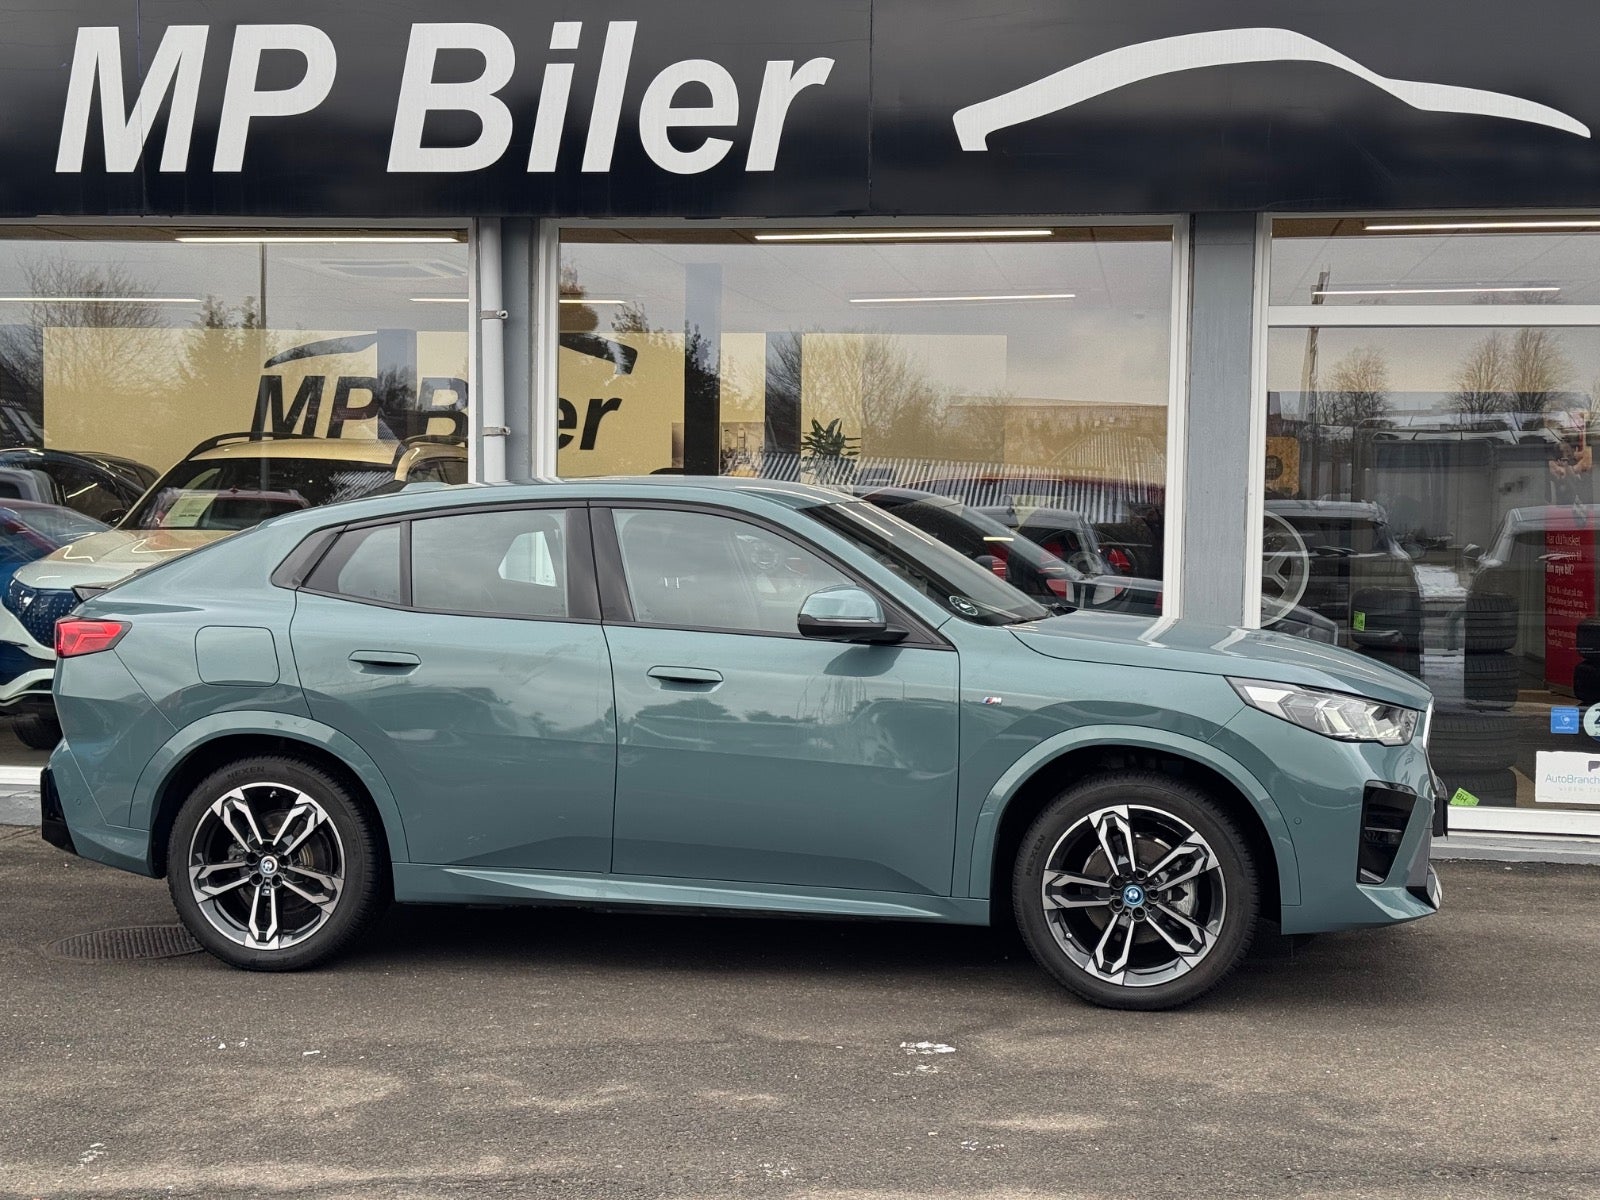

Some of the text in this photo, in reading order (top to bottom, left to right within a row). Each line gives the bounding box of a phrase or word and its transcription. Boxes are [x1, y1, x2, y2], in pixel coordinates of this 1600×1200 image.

[55, 20, 836, 175] MP Biler
[249, 375, 382, 441] MP
[1545, 773, 1600, 785] AutoBranch
